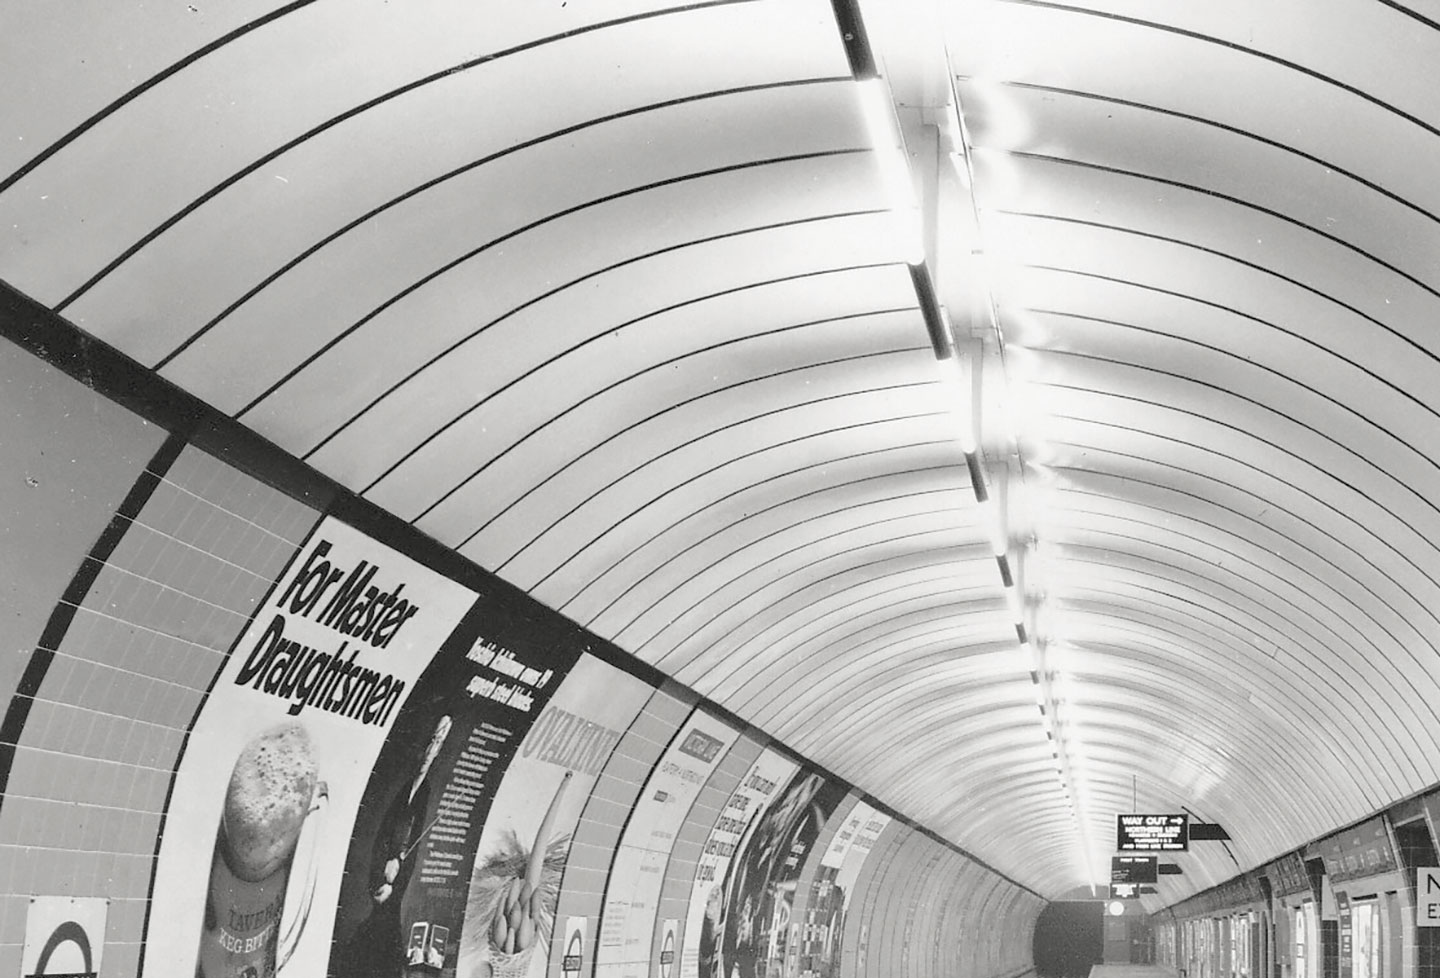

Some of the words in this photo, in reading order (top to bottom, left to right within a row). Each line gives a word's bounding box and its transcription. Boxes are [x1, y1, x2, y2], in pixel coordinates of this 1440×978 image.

[276, 540, 345, 617] For
[316, 560, 420, 649] Master
[234, 614, 406, 728] Draughtsmen
[1122, 816, 1143, 825] WAY
[1146, 816, 1168, 825] OUT
[219, 927, 243, 953] KEG
